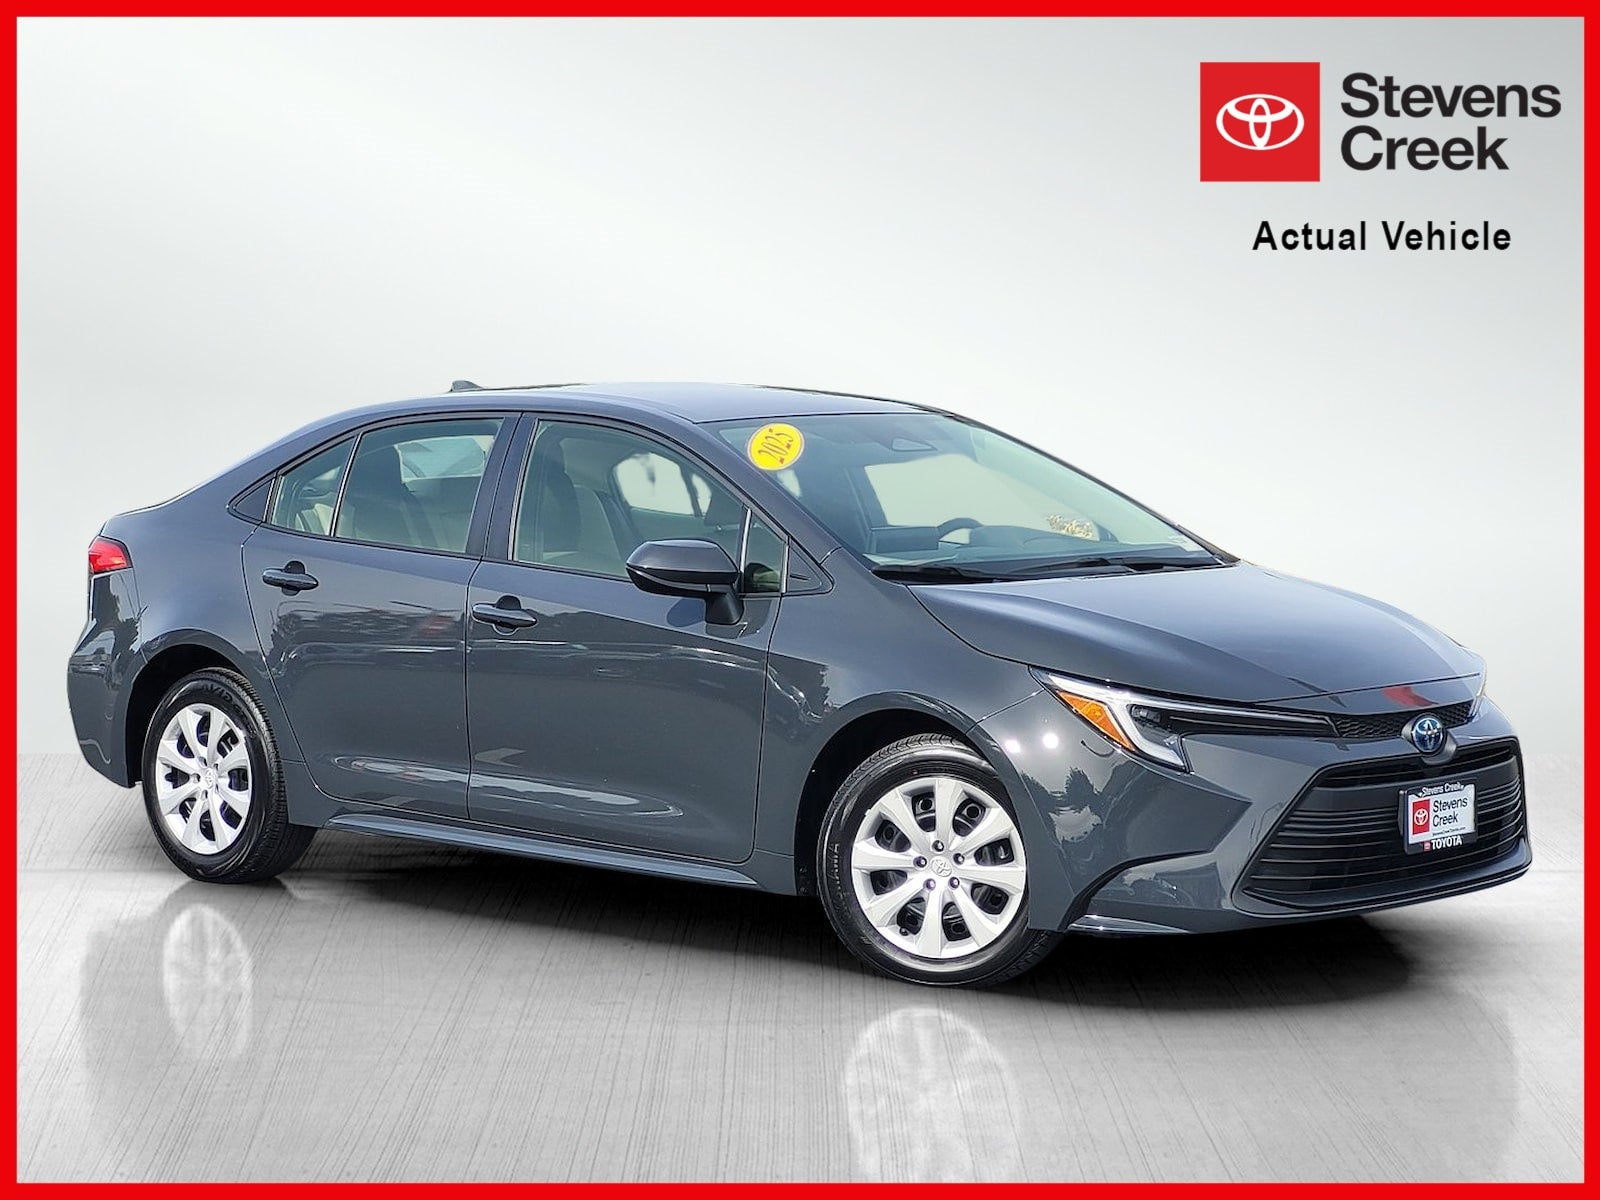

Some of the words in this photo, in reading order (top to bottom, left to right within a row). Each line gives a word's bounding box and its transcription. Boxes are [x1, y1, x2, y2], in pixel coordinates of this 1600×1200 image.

[757, 428, 794, 464] 2025
[1422, 786, 1444, 796] Stevens
[1444, 782, 1461, 792] Creek
[1433, 797, 1468, 812] Stevens
[1432, 811, 1458, 827] Creek
[1431, 834, 1462, 850] TOYOTA
